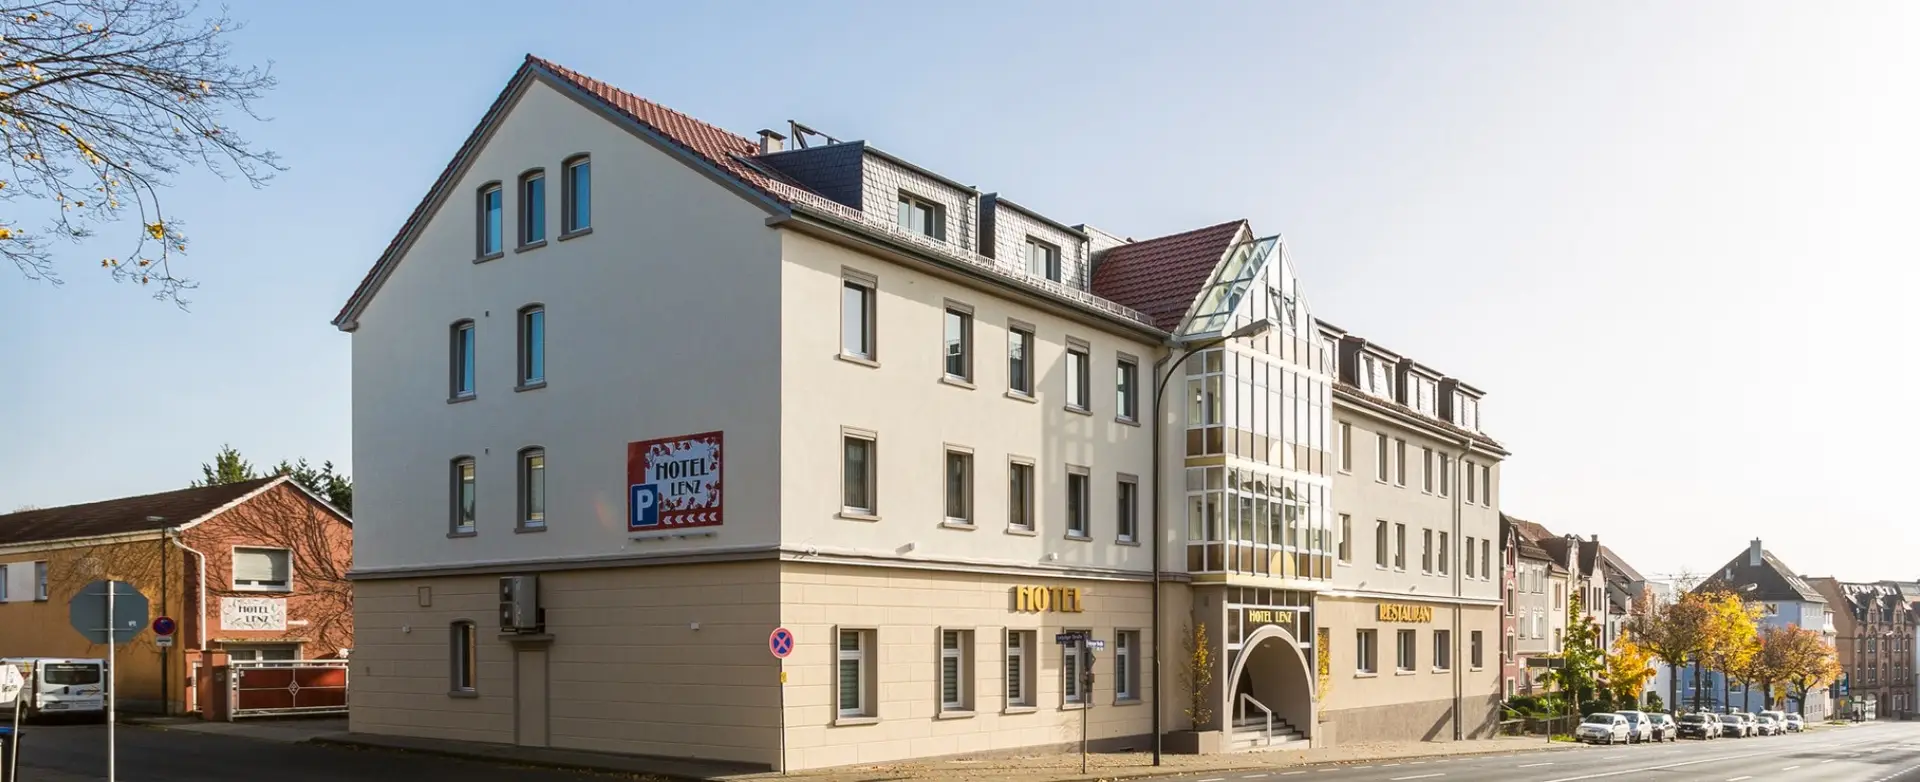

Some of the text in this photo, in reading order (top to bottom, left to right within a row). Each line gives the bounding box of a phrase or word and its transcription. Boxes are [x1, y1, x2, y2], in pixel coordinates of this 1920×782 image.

[655, 458, 709, 481] HOTEL
[670, 480, 701, 496] LENZ
[636, 489, 654, 522] P
[238, 605, 269, 613] HOTEL
[1016, 586, 1084, 613] HOTEL
[1249, 610, 1292, 623] HOTEL LENZ
